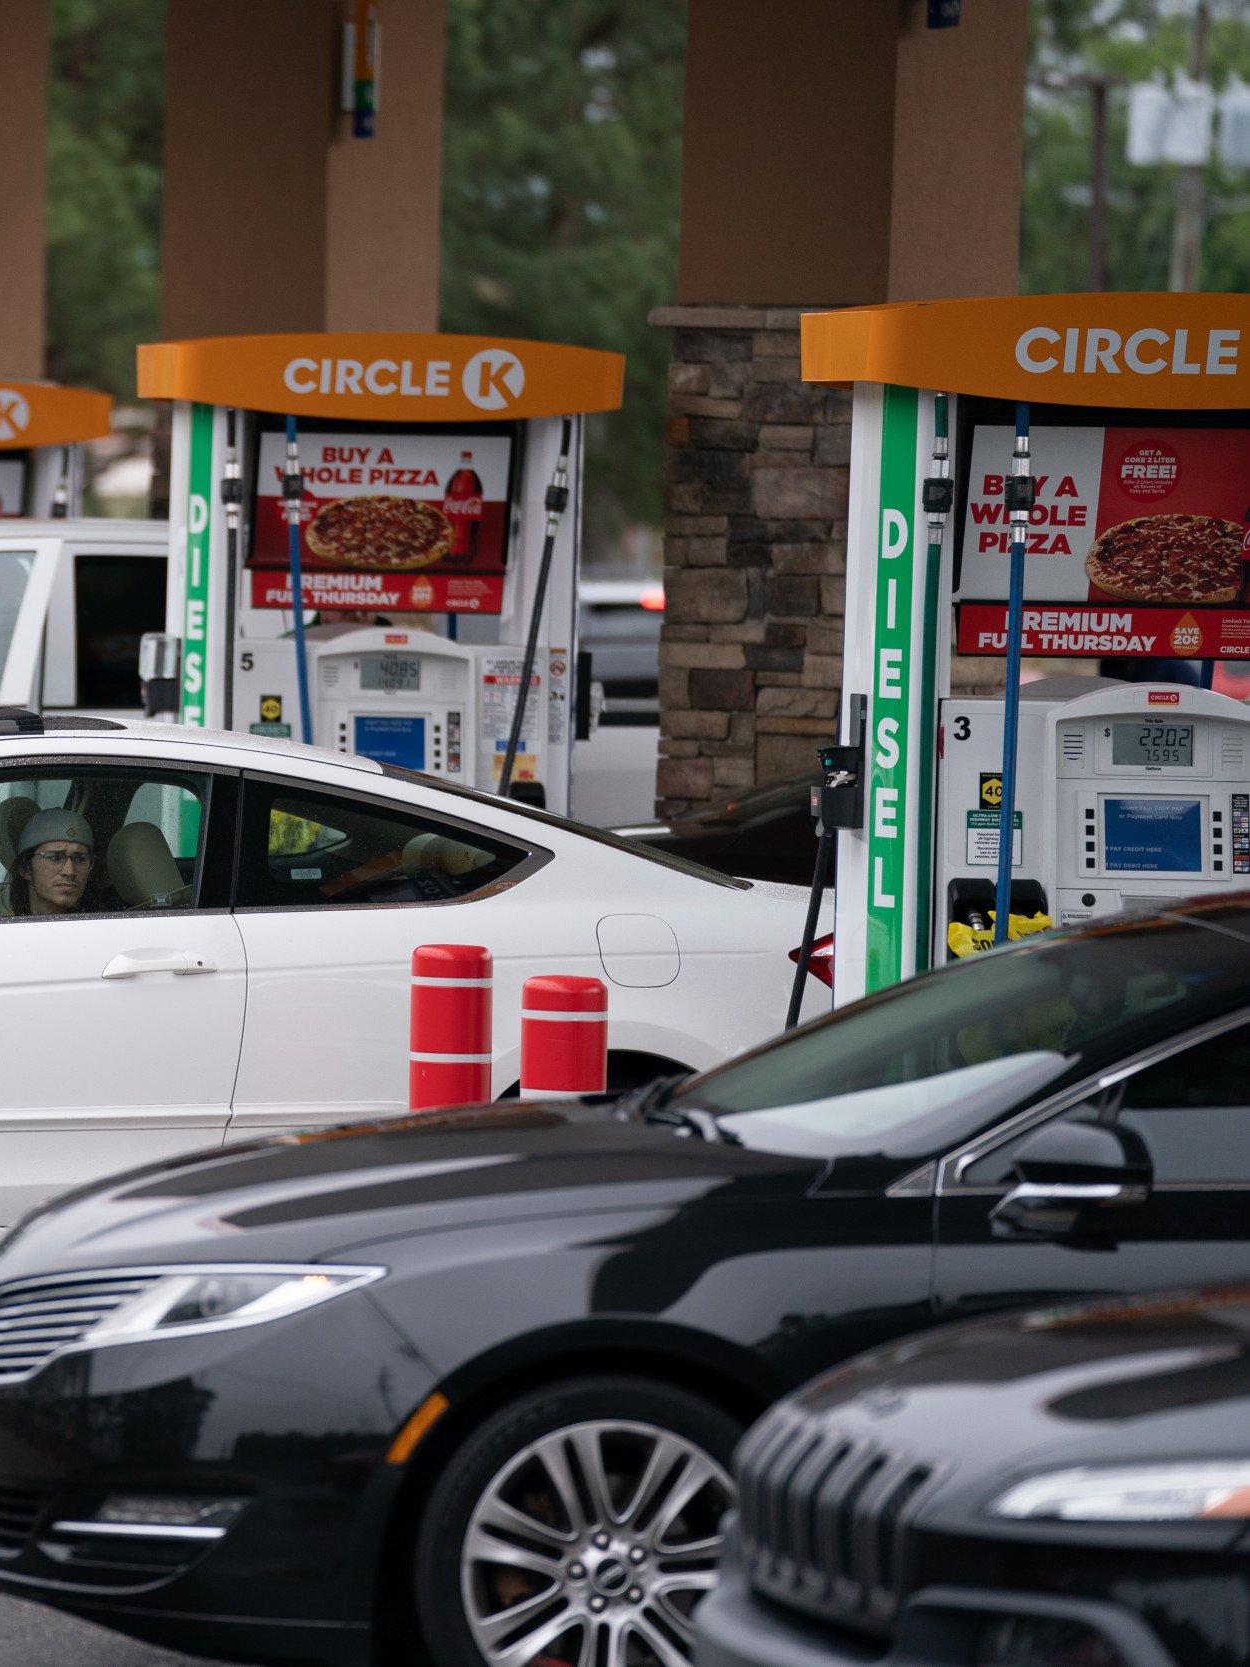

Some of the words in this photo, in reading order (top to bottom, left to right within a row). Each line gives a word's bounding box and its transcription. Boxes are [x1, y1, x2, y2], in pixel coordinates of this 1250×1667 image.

[1015, 327, 1240, 375] CIRCLE
[283, 357, 452, 397] CIRCLE
[321, 447, 373, 465] BUY
[376, 448, 395, 465] A
[368, 468, 440, 487] PIZZA
[1121, 465, 1177, 478] FREE!
[982, 474, 1049, 497] BY
[1054, 475, 1079, 498] A
[310, 591, 400, 606] THURSDAY
[1004, 610, 1132, 633] REMIUM
[1173, 634, 1199, 645] 20¢
[1174, 627, 1200, 635] SAVE
[978, 632, 1034, 649] FUL
[1038, 634, 1157, 652] THURSDAY
[1219, 646, 1250, 654] CIRCLE
[240, 653, 254, 671] 5
[873, 508, 908, 909] DIESEL
[953, 715, 972, 741] 3
[1104, 727, 1111, 738] $
[1139, 727, 1191, 748] 22.02
[1144, 749, 1180, 762] 7.595
[985, 786, 1002, 797] 40
